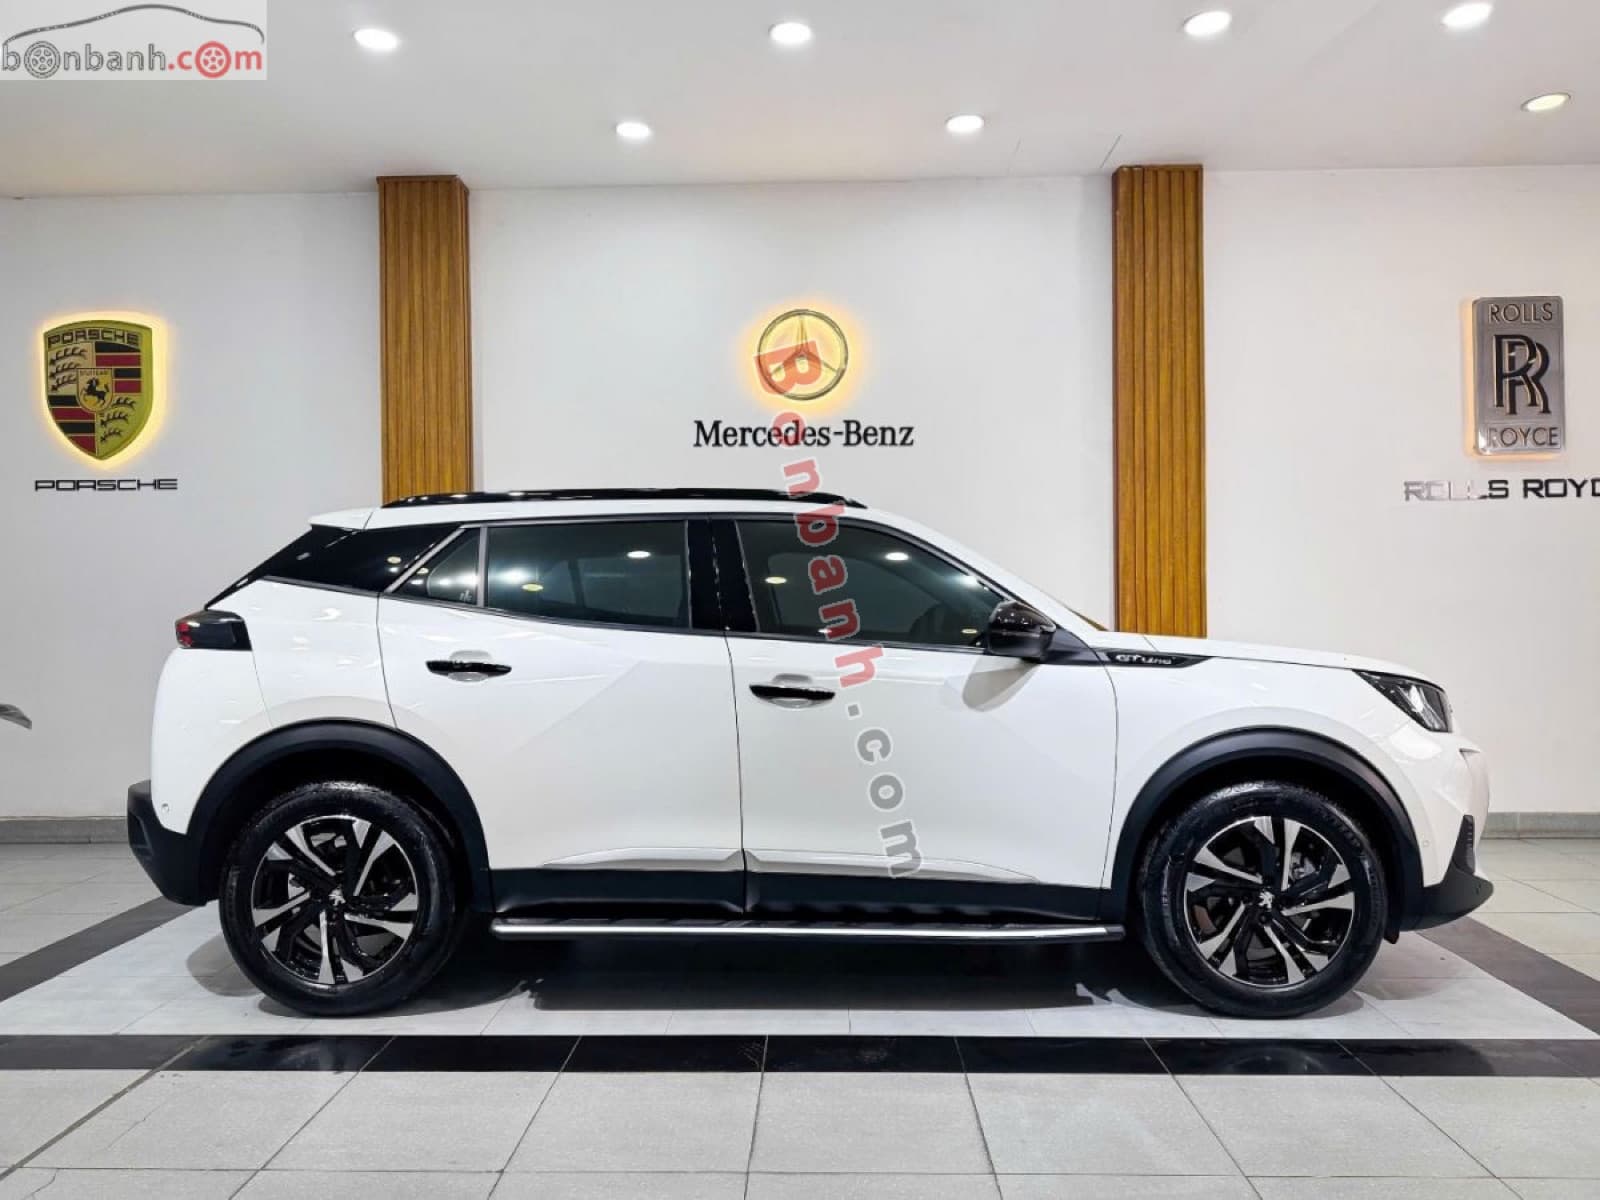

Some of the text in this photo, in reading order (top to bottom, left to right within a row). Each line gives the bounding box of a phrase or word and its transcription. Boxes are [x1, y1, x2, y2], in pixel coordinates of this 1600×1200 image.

[1488, 303, 1554, 323] ROLLS
[48, 328, 140, 347] PORSCHE
[693, 419, 915, 448] Mercedes-Benz
[1488, 427, 1559, 448] ROYCE
[34, 478, 178, 492] PORSCHE
